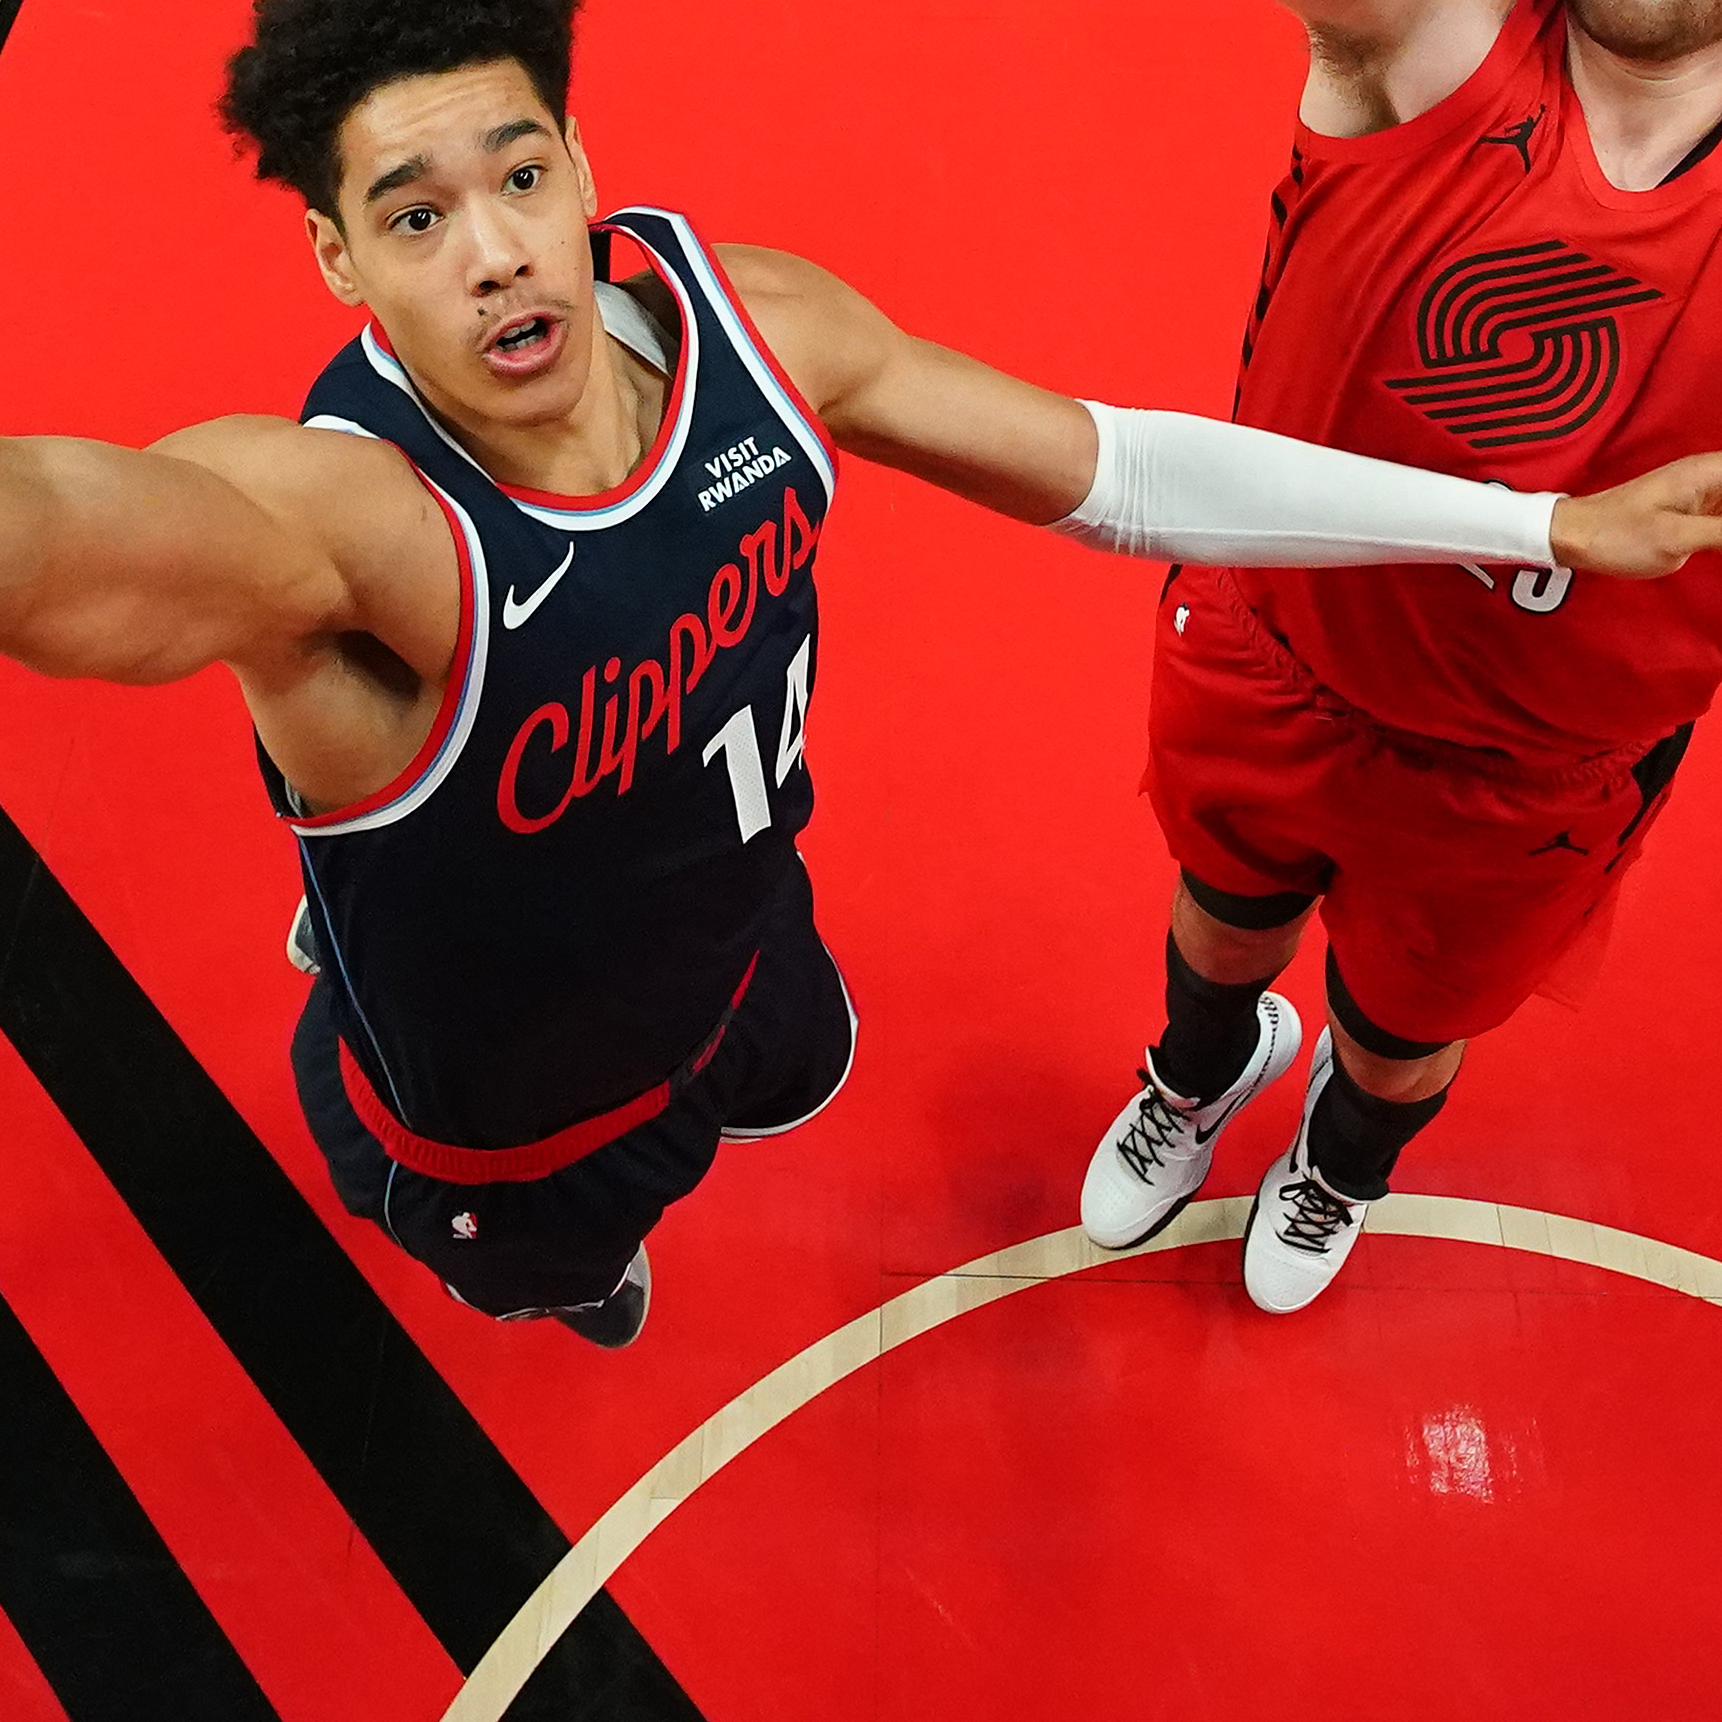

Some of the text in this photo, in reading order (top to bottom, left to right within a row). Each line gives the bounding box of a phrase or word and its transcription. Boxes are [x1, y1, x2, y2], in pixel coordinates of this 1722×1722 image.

[697, 446, 792, 512] RWANDA
[704, 436, 759, 479] VISIT
[496, 485, 821, 834] Clippers
[701, 633, 810, 845] 14
